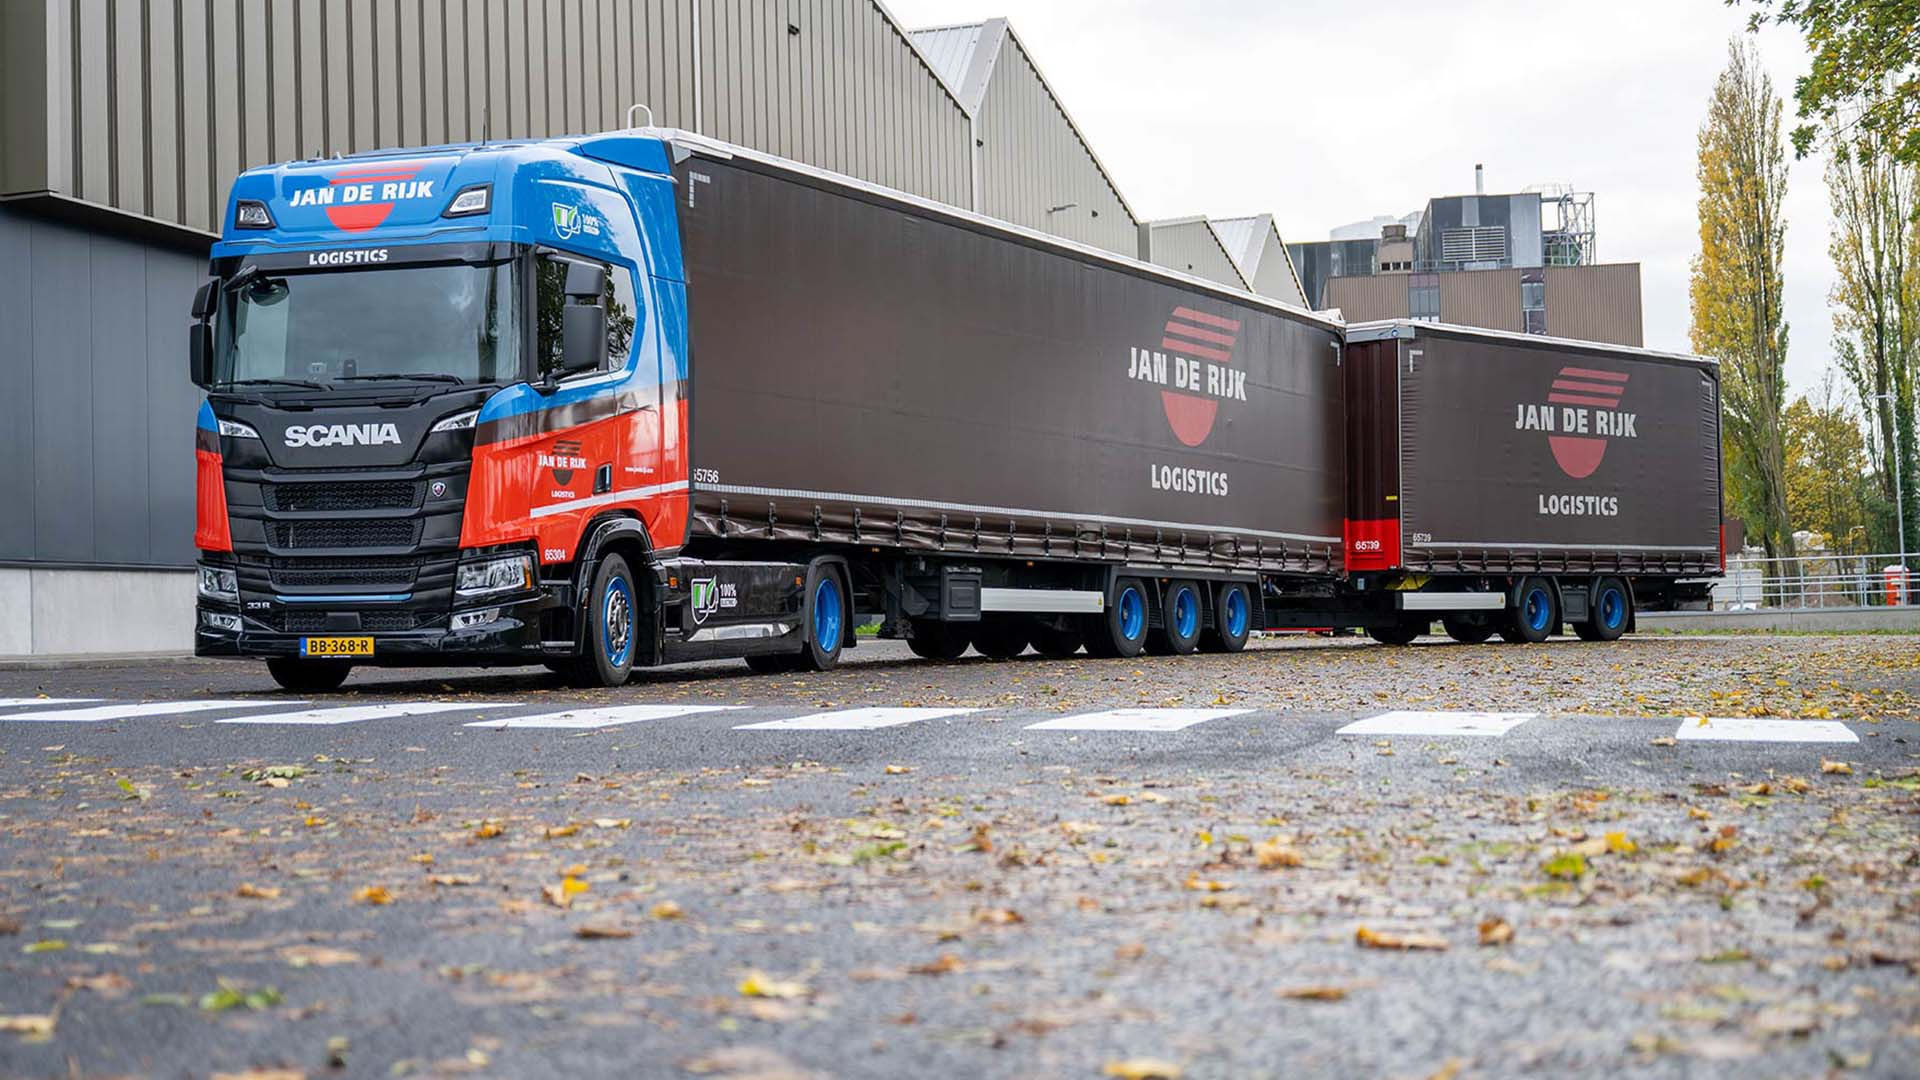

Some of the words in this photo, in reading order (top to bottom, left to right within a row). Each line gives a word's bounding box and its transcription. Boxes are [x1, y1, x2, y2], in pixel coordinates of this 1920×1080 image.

[290, 187, 335, 207] JAN
[342, 184, 373, 203] DE
[382, 180, 434, 200] RIJK
[309, 249, 388, 266] LOGISTICS
[1128, 347, 1168, 385] JAN
[1175, 356, 1200, 391] DE
[1207, 363, 1247, 401] RIJK
[1515, 404, 1555, 431] JAN
[1563, 407, 1588, 434] DE
[1596, 410, 1637, 438] RIJK
[284, 423, 402, 448] SCANIA
[538, 455, 554, 468] JAN
[557, 456, 568, 469] DE
[570, 457, 587, 470] RIJK
[1151, 464, 1228, 497] LOGISTICS
[1539, 494, 1618, 516] LOGISTICS
[544, 548, 566, 561] 65304
[720, 583, 736, 597] 100%
[310, 640, 369, 653] BB-368-R
